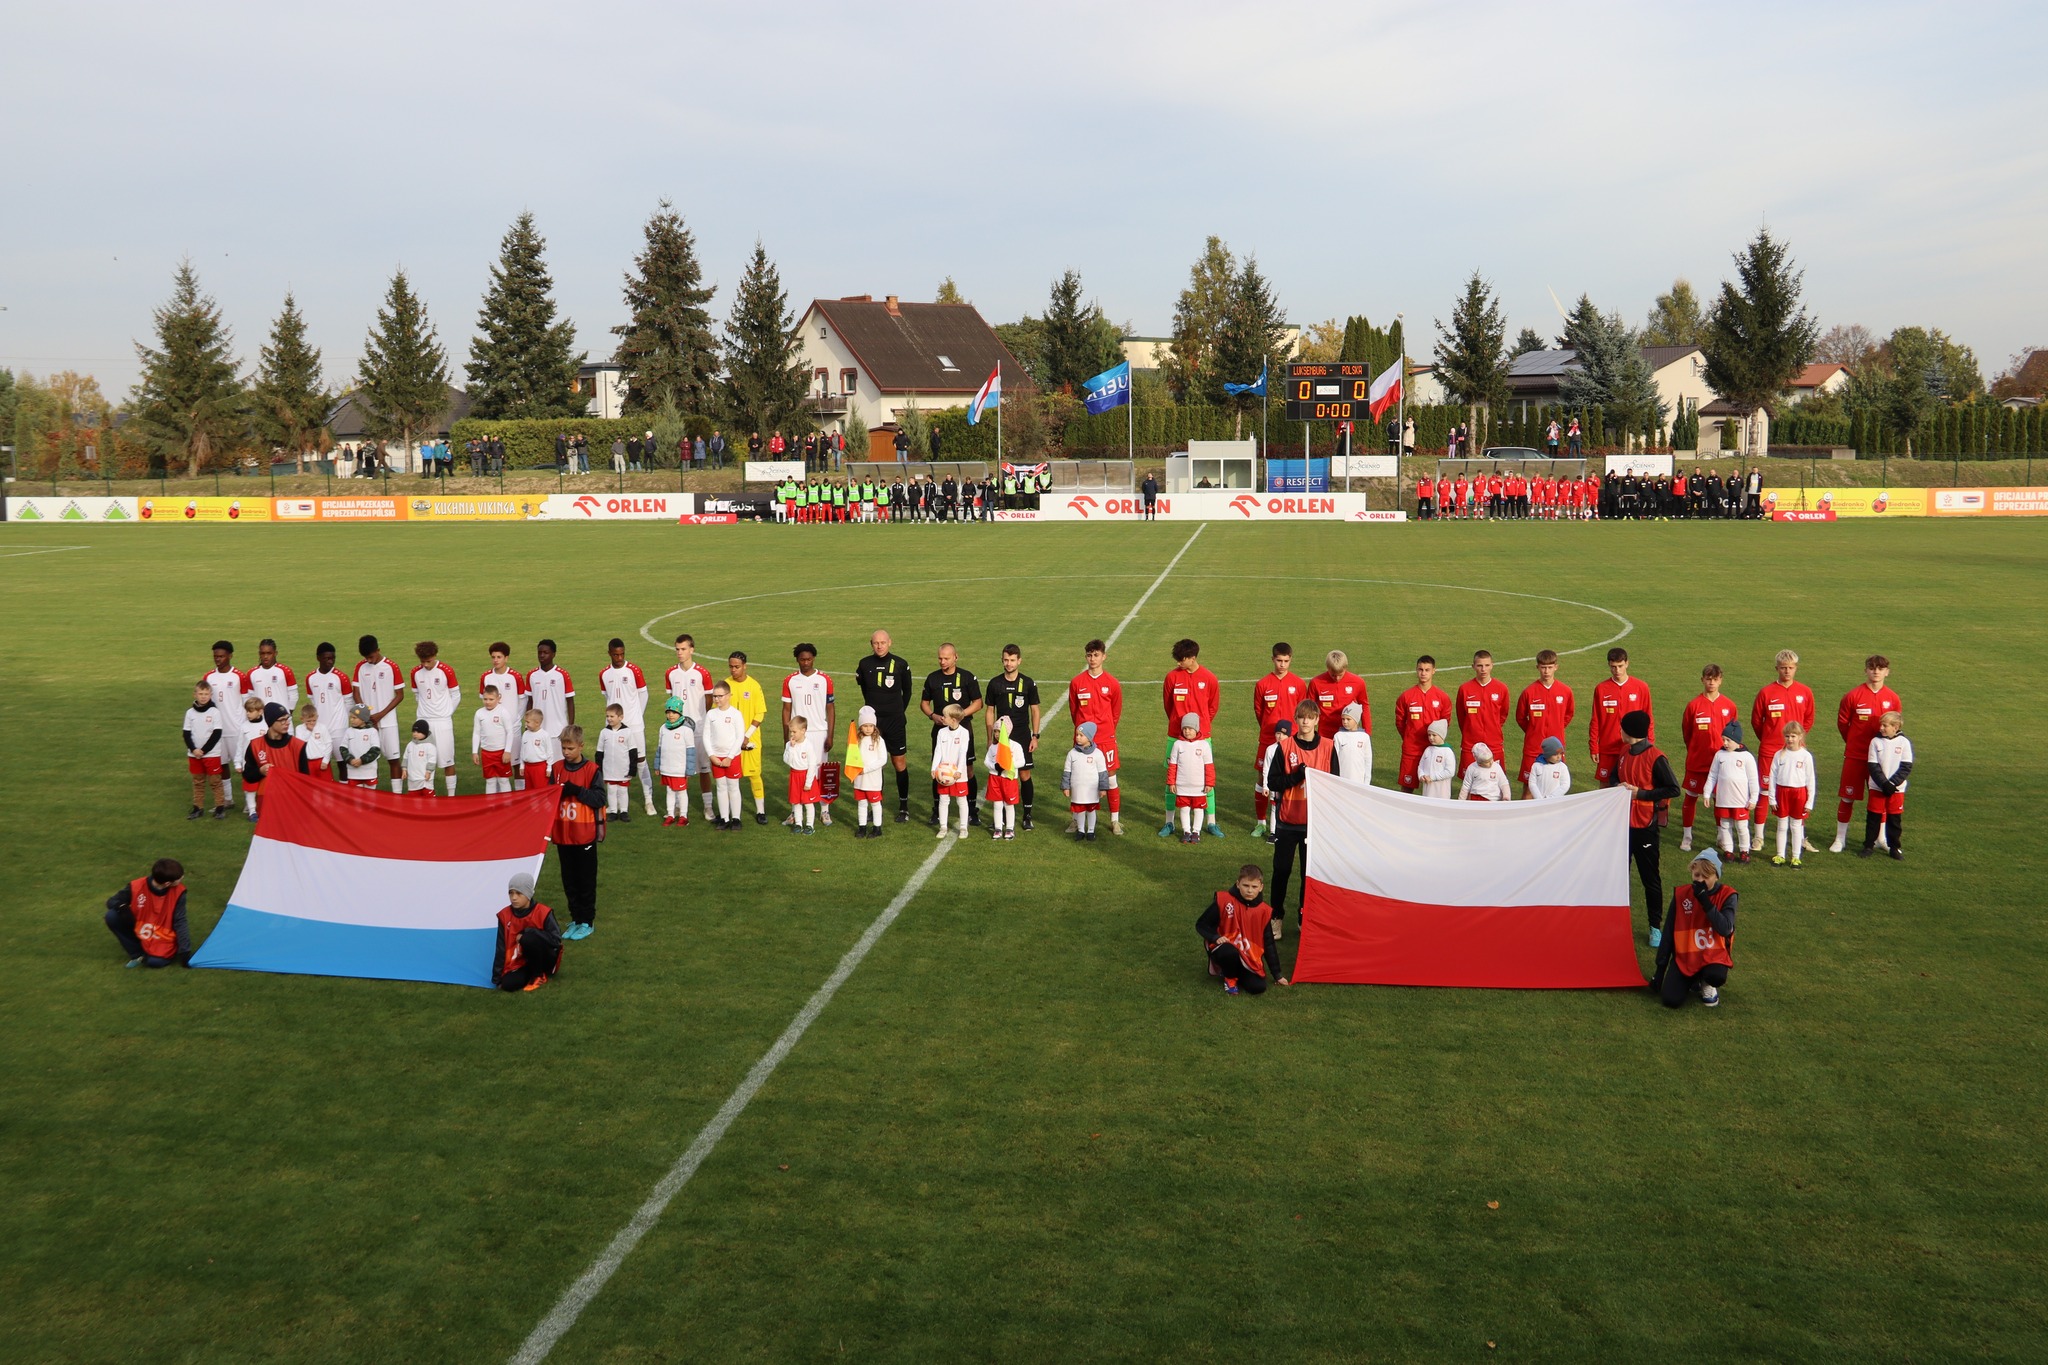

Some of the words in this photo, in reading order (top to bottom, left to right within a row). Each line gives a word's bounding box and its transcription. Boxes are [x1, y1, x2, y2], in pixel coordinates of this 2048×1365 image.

[1293, 365, 1327, 376] LUKSEMBURG
[1341, 365, 1363, 375] POLSKA
[1298, 381, 1311, 400] 0
[1353, 381, 1366, 400] 0
[1316, 403, 1351, 418] 0:00
[1993, 491, 2036, 501] OFICJALNA
[321, 500, 356, 509] OFICJALNA
[434, 502, 476, 515] KUCHNIA
[477, 501, 516, 514] VIKINGA
[606, 499, 667, 513] ORLEN
[1105, 499, 1171, 514] ORLN
[1267, 498, 1334, 514] ORLEN
[322, 509, 372, 518] REPREZENTACJI
[372, 509, 396, 517] POLSKI
[264, 686, 272, 698] 16
[320, 692, 325, 704] 6
[427, 688, 432, 700] 3
[682, 689, 688, 701] 5
[804, 694, 812, 706] 10
[1106, 749, 1115, 763] 17
